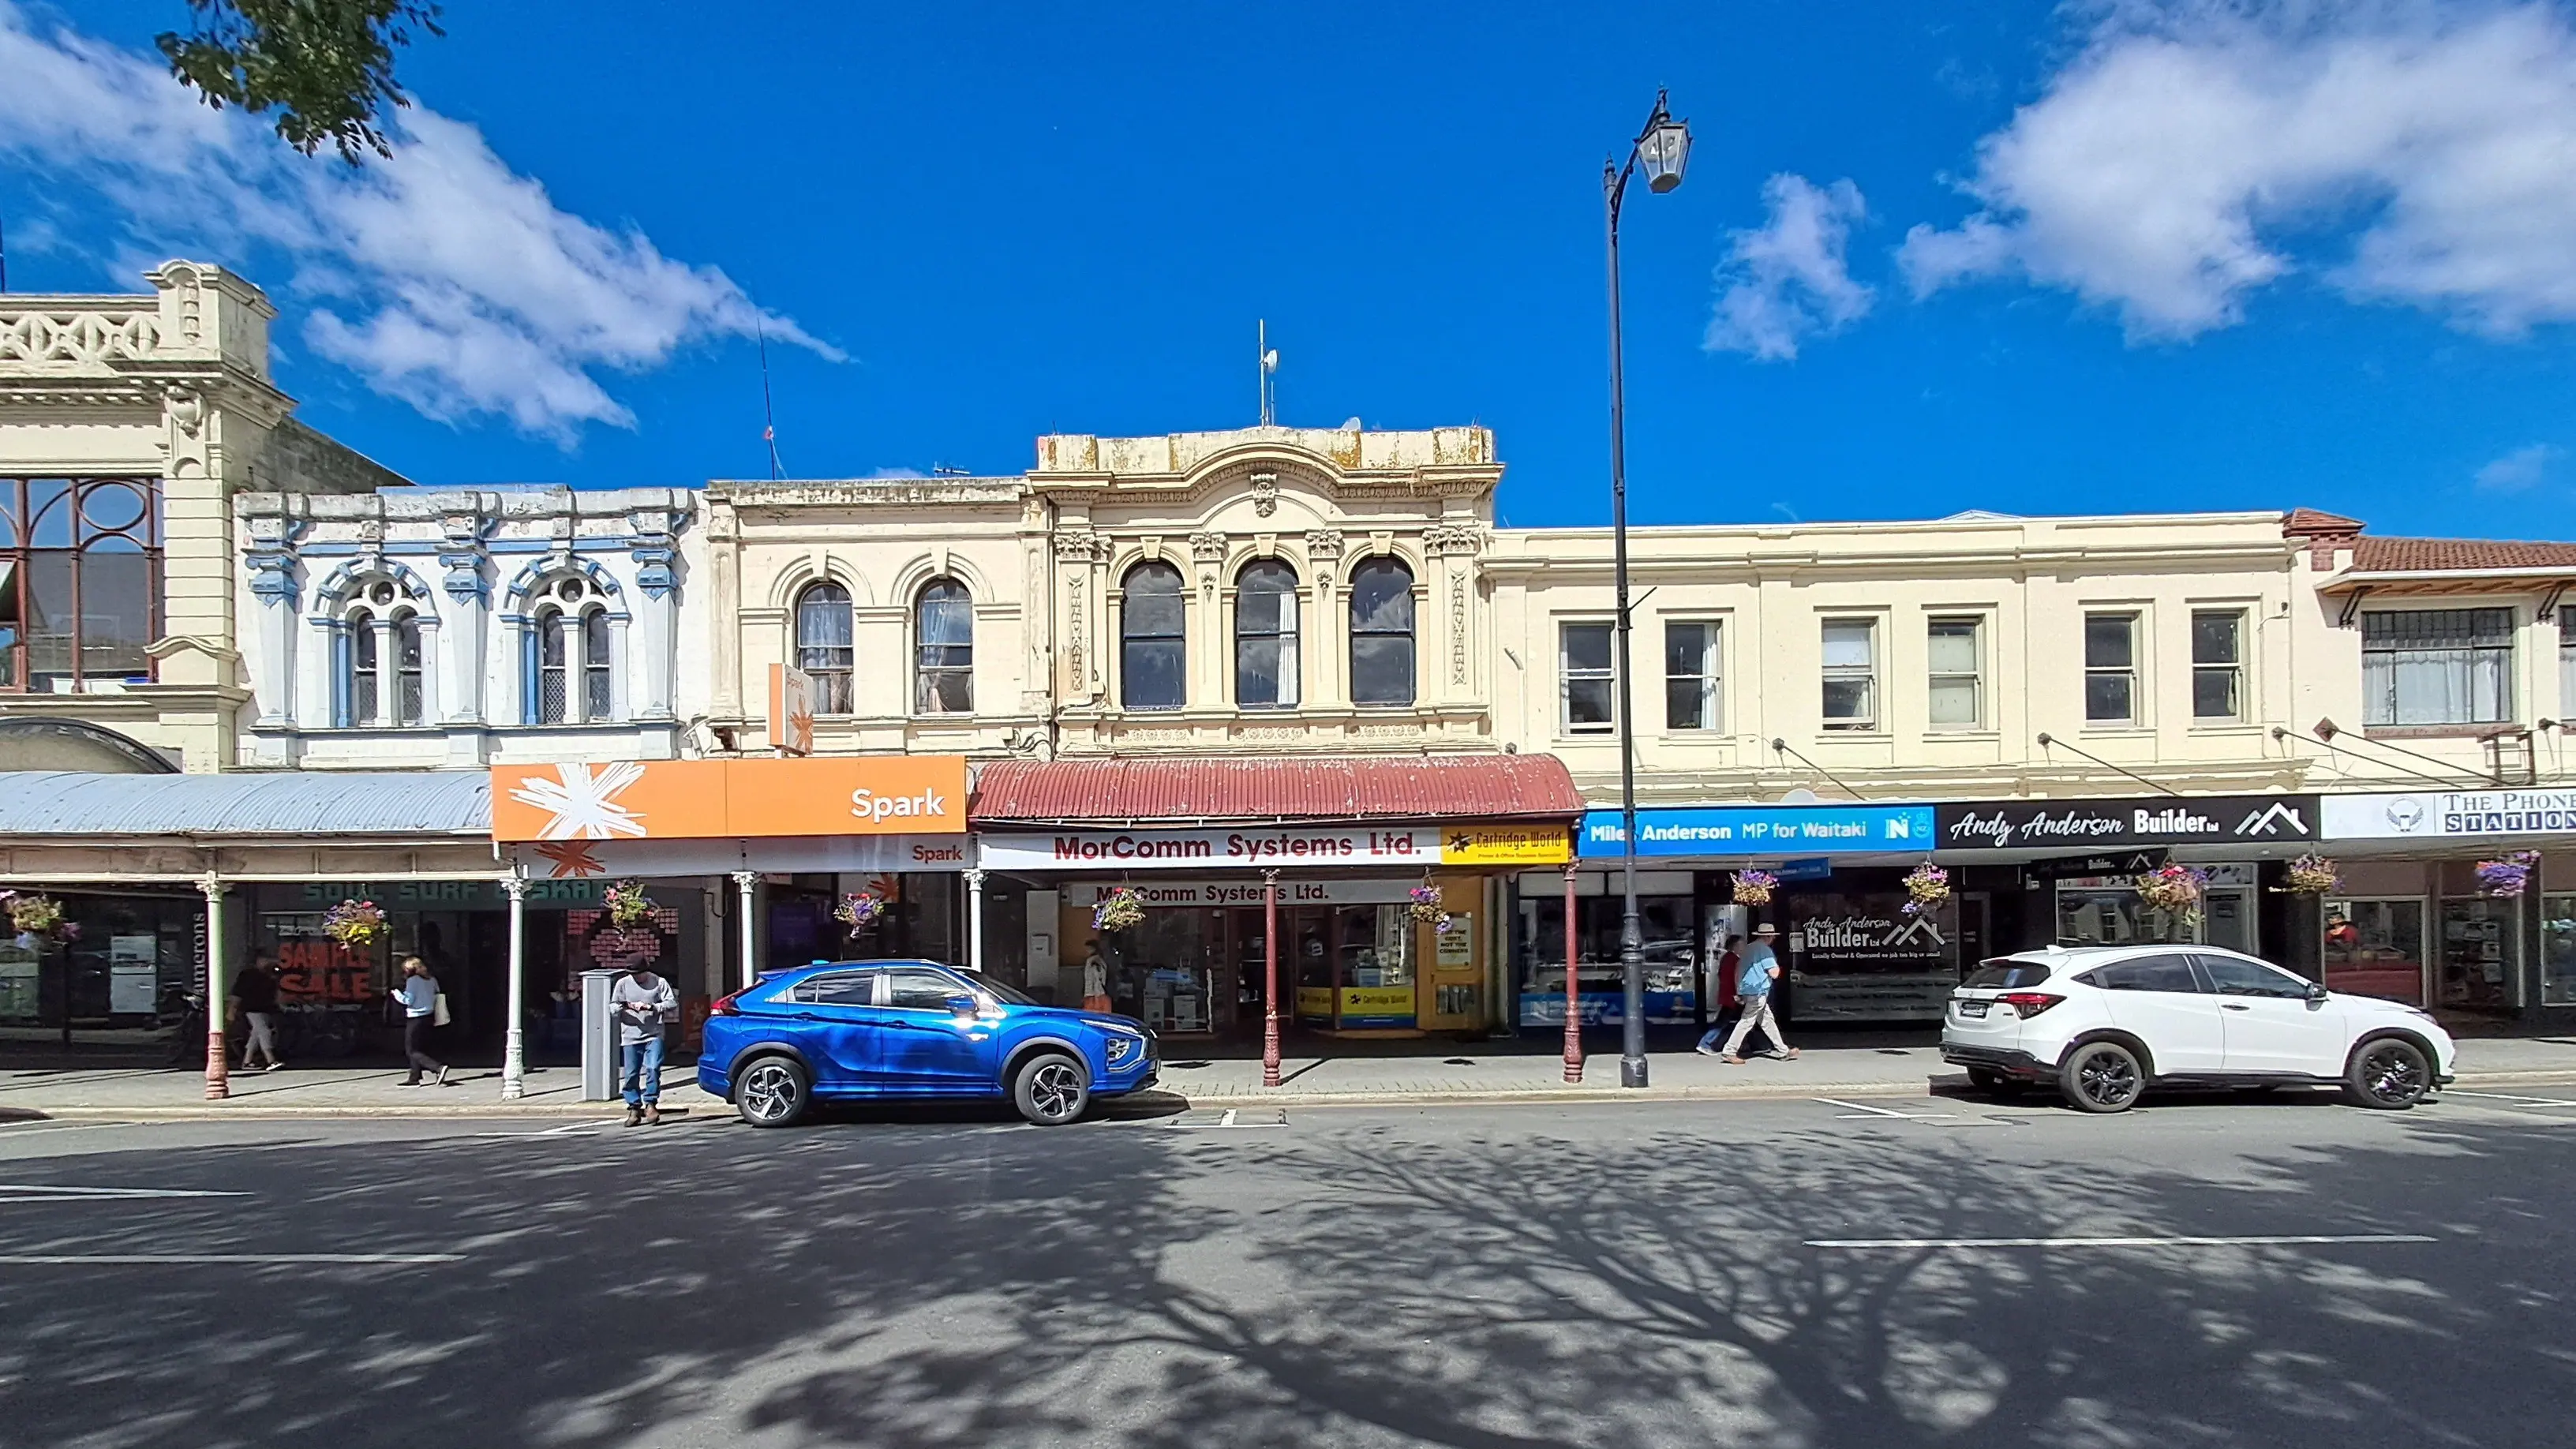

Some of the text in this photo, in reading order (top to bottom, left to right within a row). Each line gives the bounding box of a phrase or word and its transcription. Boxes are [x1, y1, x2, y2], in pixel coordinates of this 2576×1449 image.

[851, 787, 946, 824] Spark
[1590, 821, 1866, 842] Mile Anderson MP for Waitaki
[1950, 811, 2016, 848] Andy
[2020, 810, 2125, 841] Anderson
[2133, 808, 2208, 834] Builder
[2446, 811, 2576, 831] STATION
[1054, 831, 1421, 863] MorComm Systems Ltd.
[1476, 830, 1561, 851] Cartridge World
[912, 844, 964, 864] Spark
[305, 882, 384, 901] SOUL
[400, 881, 480, 900] SURF
[530, 880, 611, 900] SKAT
[1096, 886, 1197, 903] MComm
[1295, 884, 1329, 900] Ltd.
[1803, 915, 1893, 934] Andy Anderson
[1807, 927, 1870, 948] Builder
[192, 912, 208, 994] amerons
[279, 941, 372, 969] SAMPLE
[279, 972, 373, 1001] SALE
